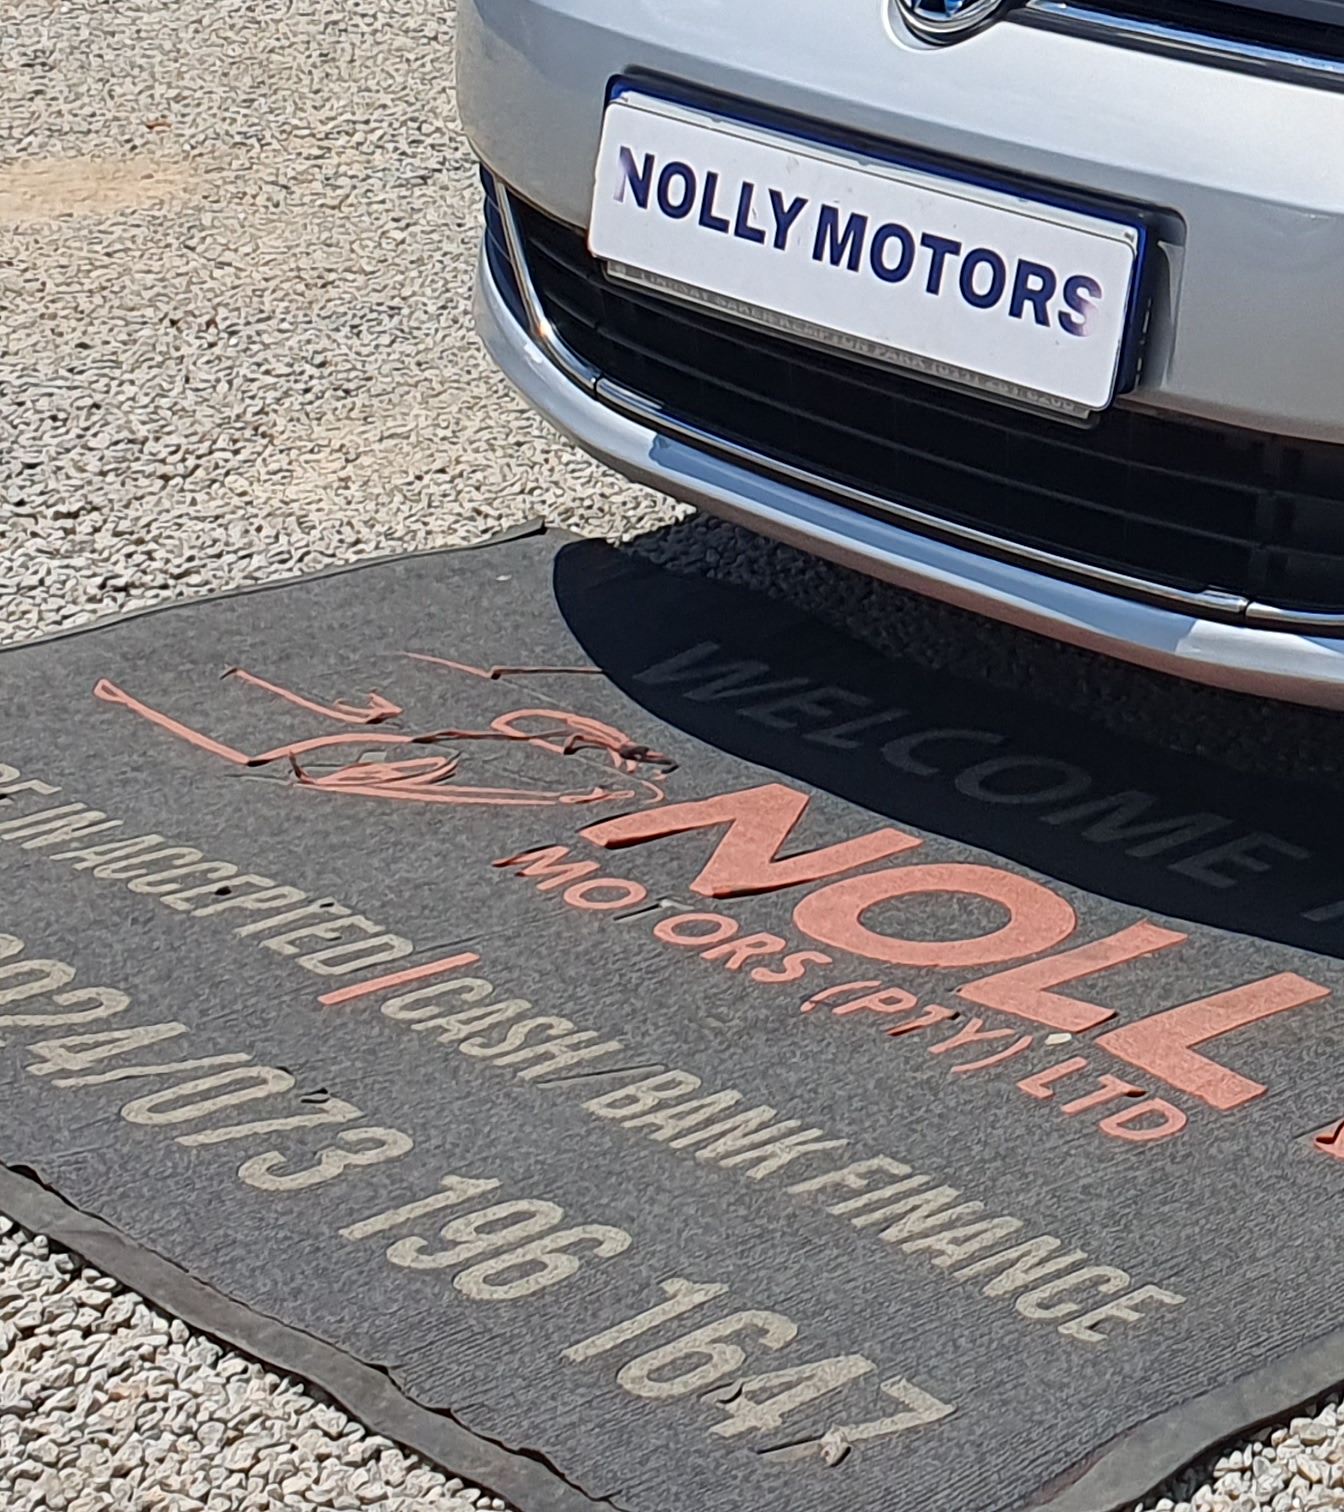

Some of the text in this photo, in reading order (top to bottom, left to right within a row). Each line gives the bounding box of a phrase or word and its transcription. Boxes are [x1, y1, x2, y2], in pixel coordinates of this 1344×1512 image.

[614, 146, 1103, 338] NOLLY MOTORS
[630, 641, 1311, 889] WELCOME
[492, 843, 1189, 1142] MOTORS (PTY) LTD
[337, 1173, 633, 1301] 196
[561, 1277, 956, 1468] 1647
[788, 1153, 1188, 1342] FINANCE
